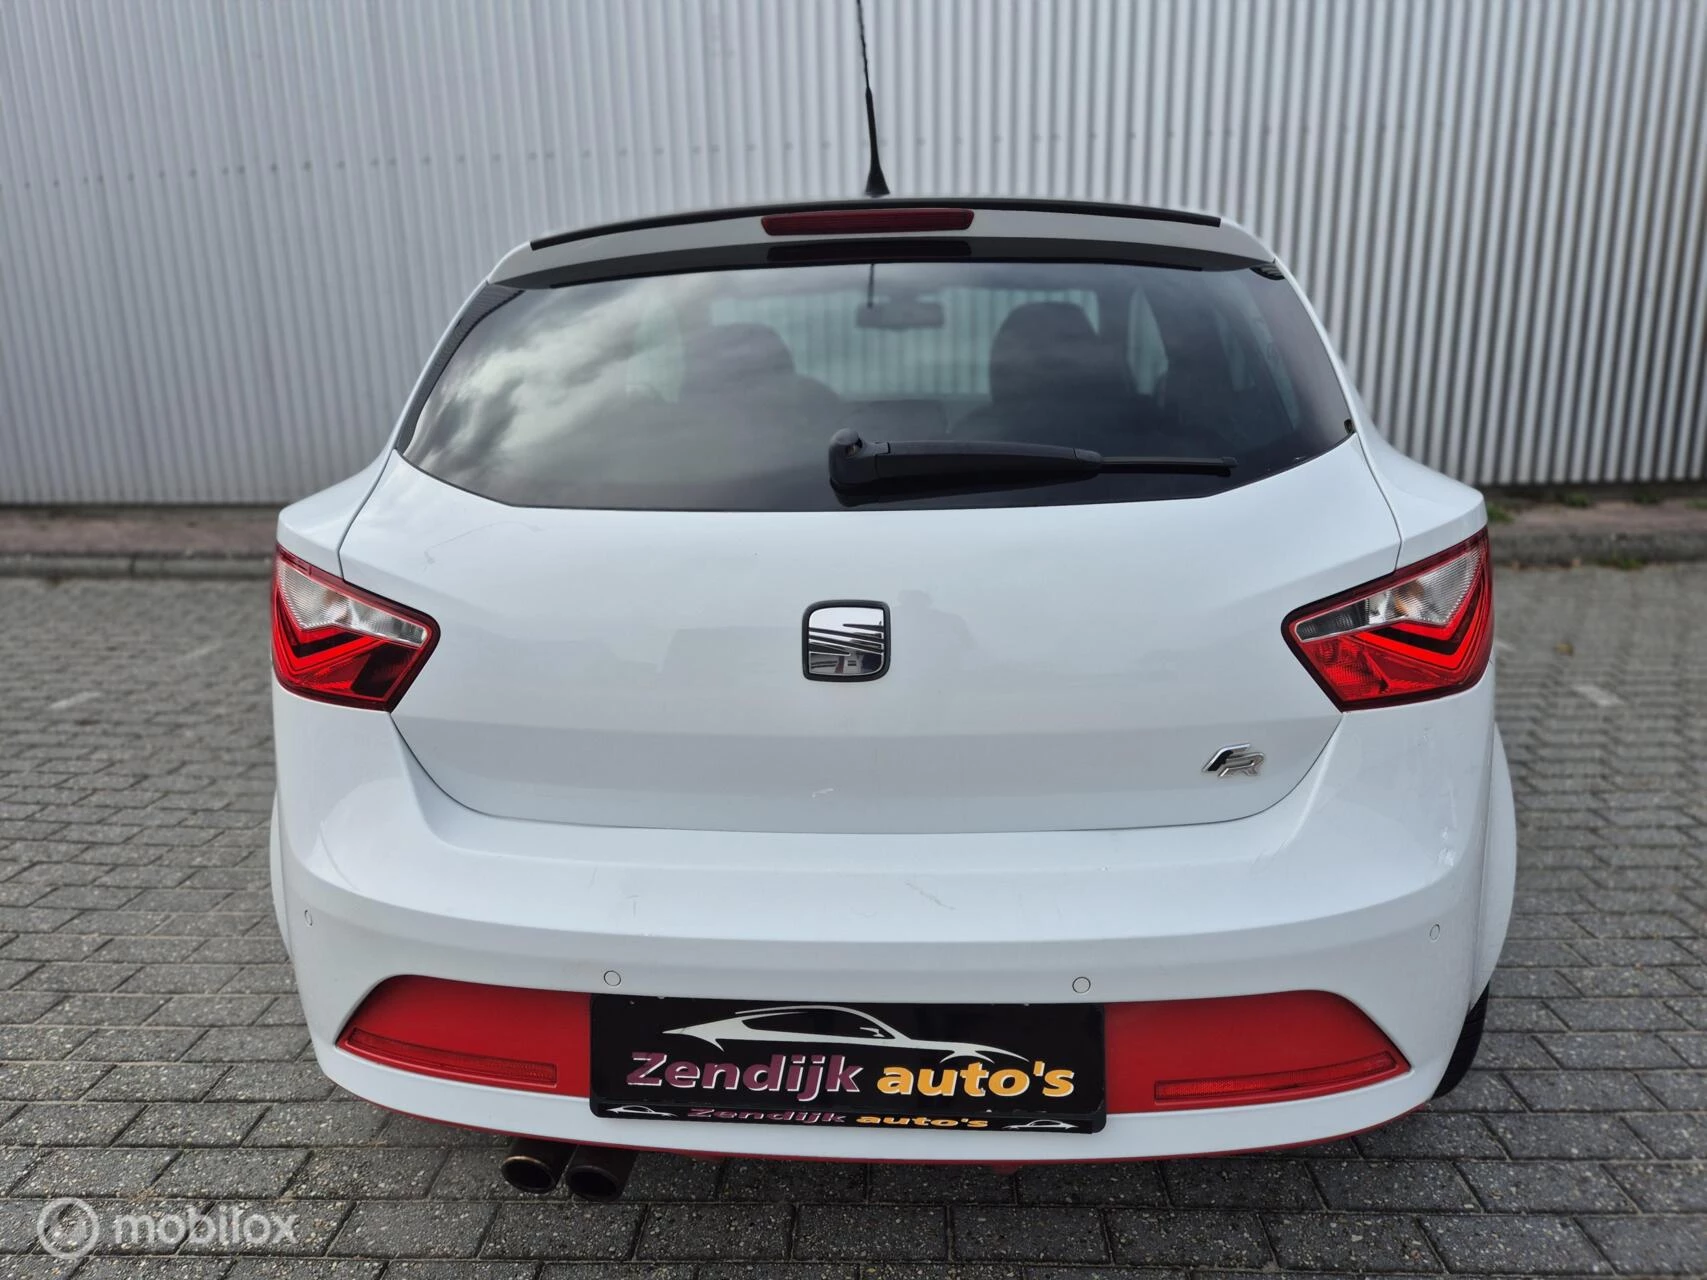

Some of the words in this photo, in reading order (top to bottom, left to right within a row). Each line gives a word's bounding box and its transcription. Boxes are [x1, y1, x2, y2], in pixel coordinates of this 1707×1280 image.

[627, 1052, 863, 1101] Zendijk
[877, 1061, 1075, 1097] auto's
[687, 1108, 846, 1123] Zendijk
[856, 1115, 989, 1128] auto's
